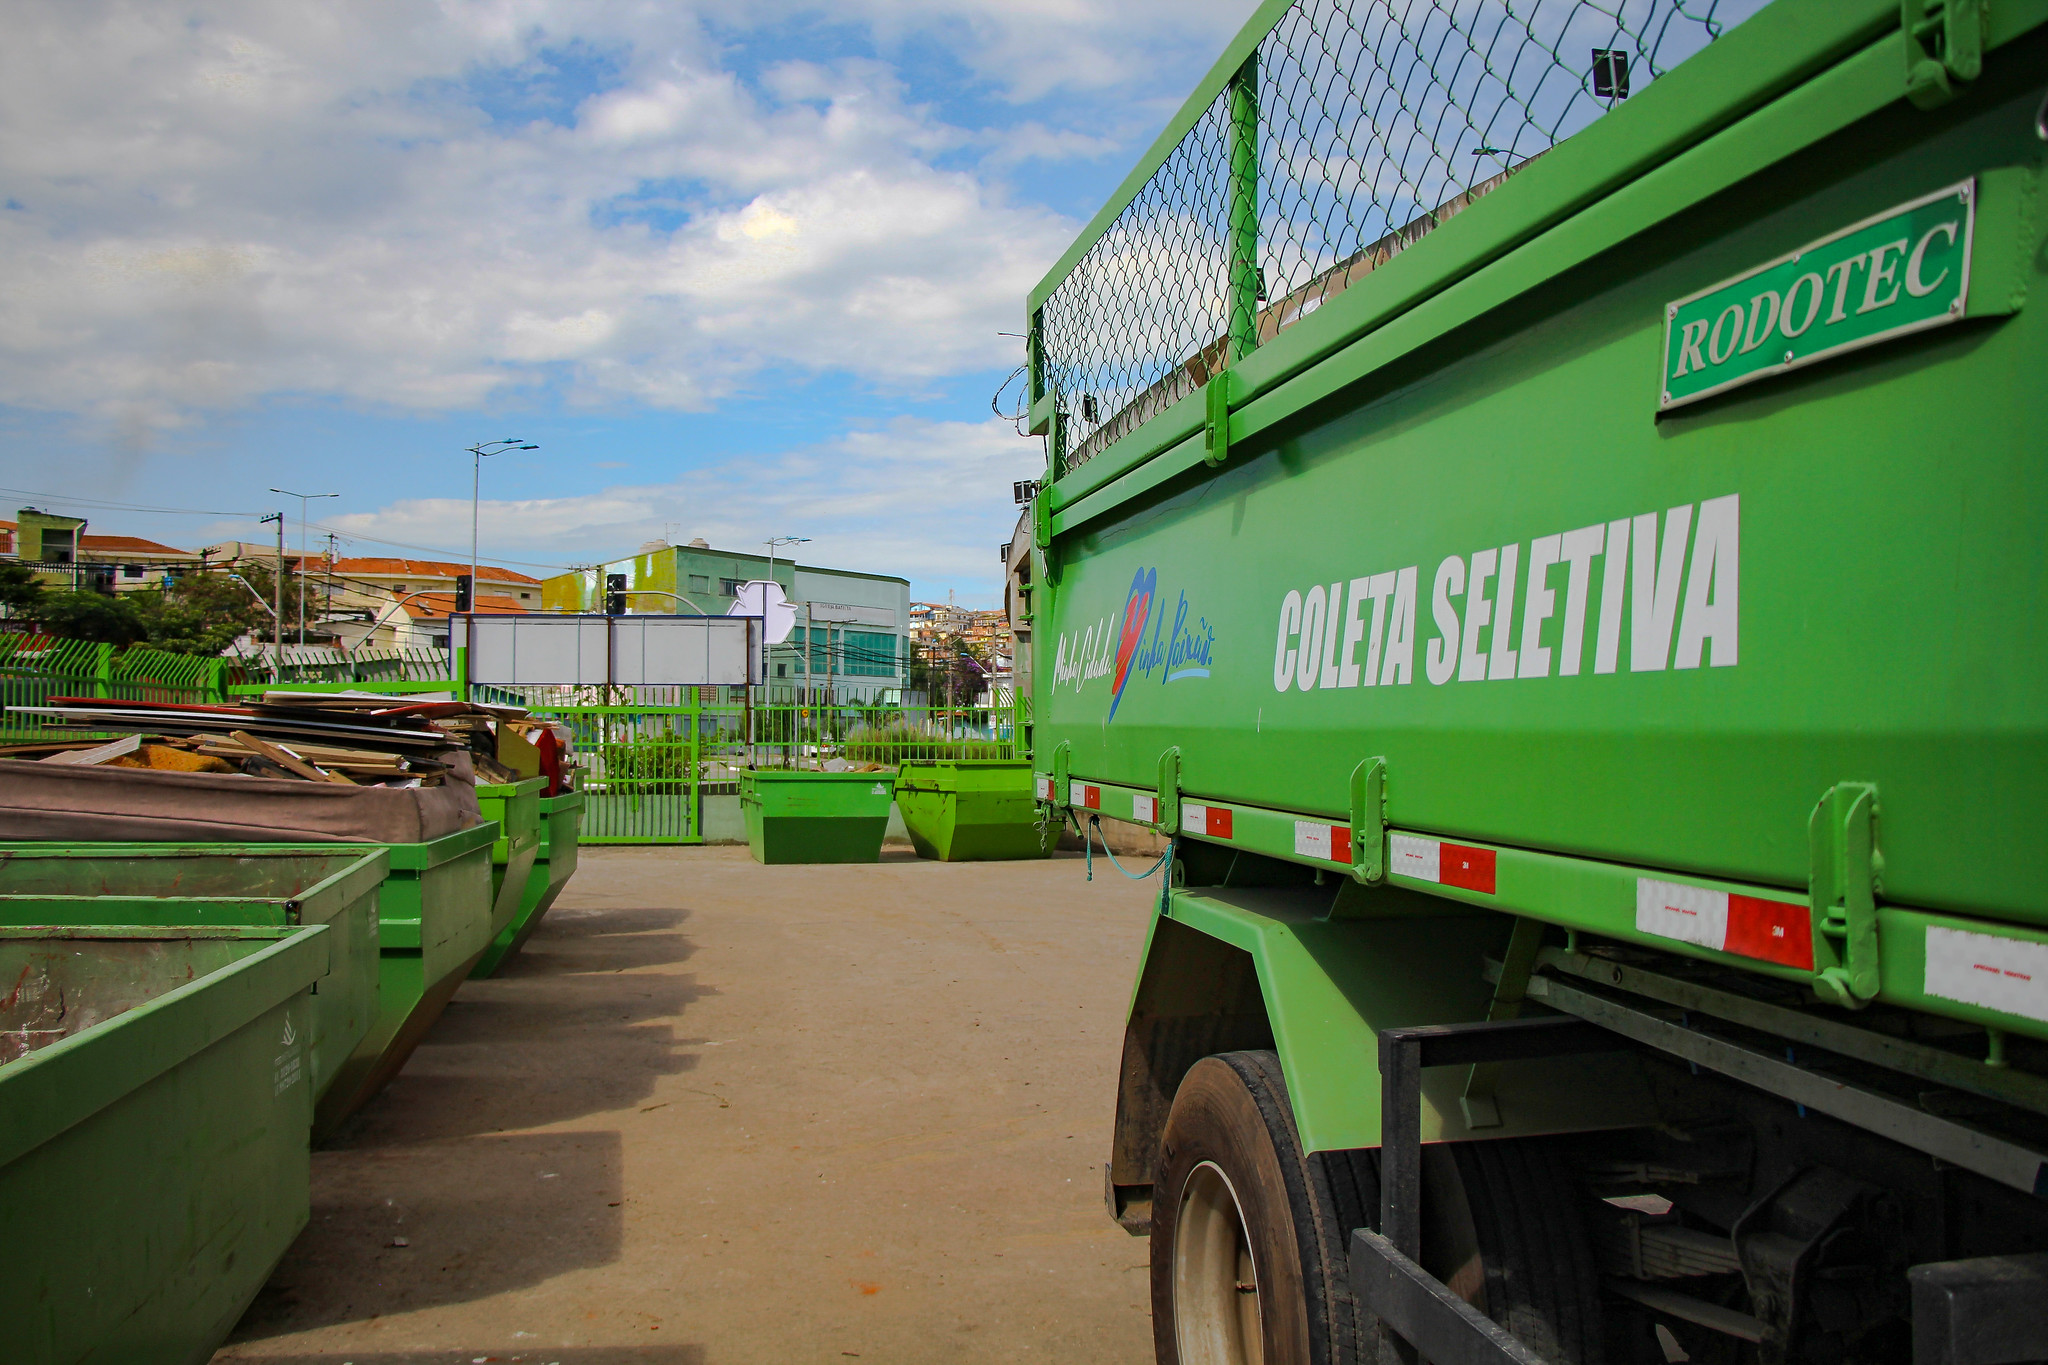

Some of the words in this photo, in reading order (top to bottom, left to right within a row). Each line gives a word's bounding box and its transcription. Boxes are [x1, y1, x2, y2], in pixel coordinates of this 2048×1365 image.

[1672, 219, 1958, 379] RODOTEC
[1273, 565, 1418, 692] COLETA
[1425, 493, 1740, 685] SELETIVA
